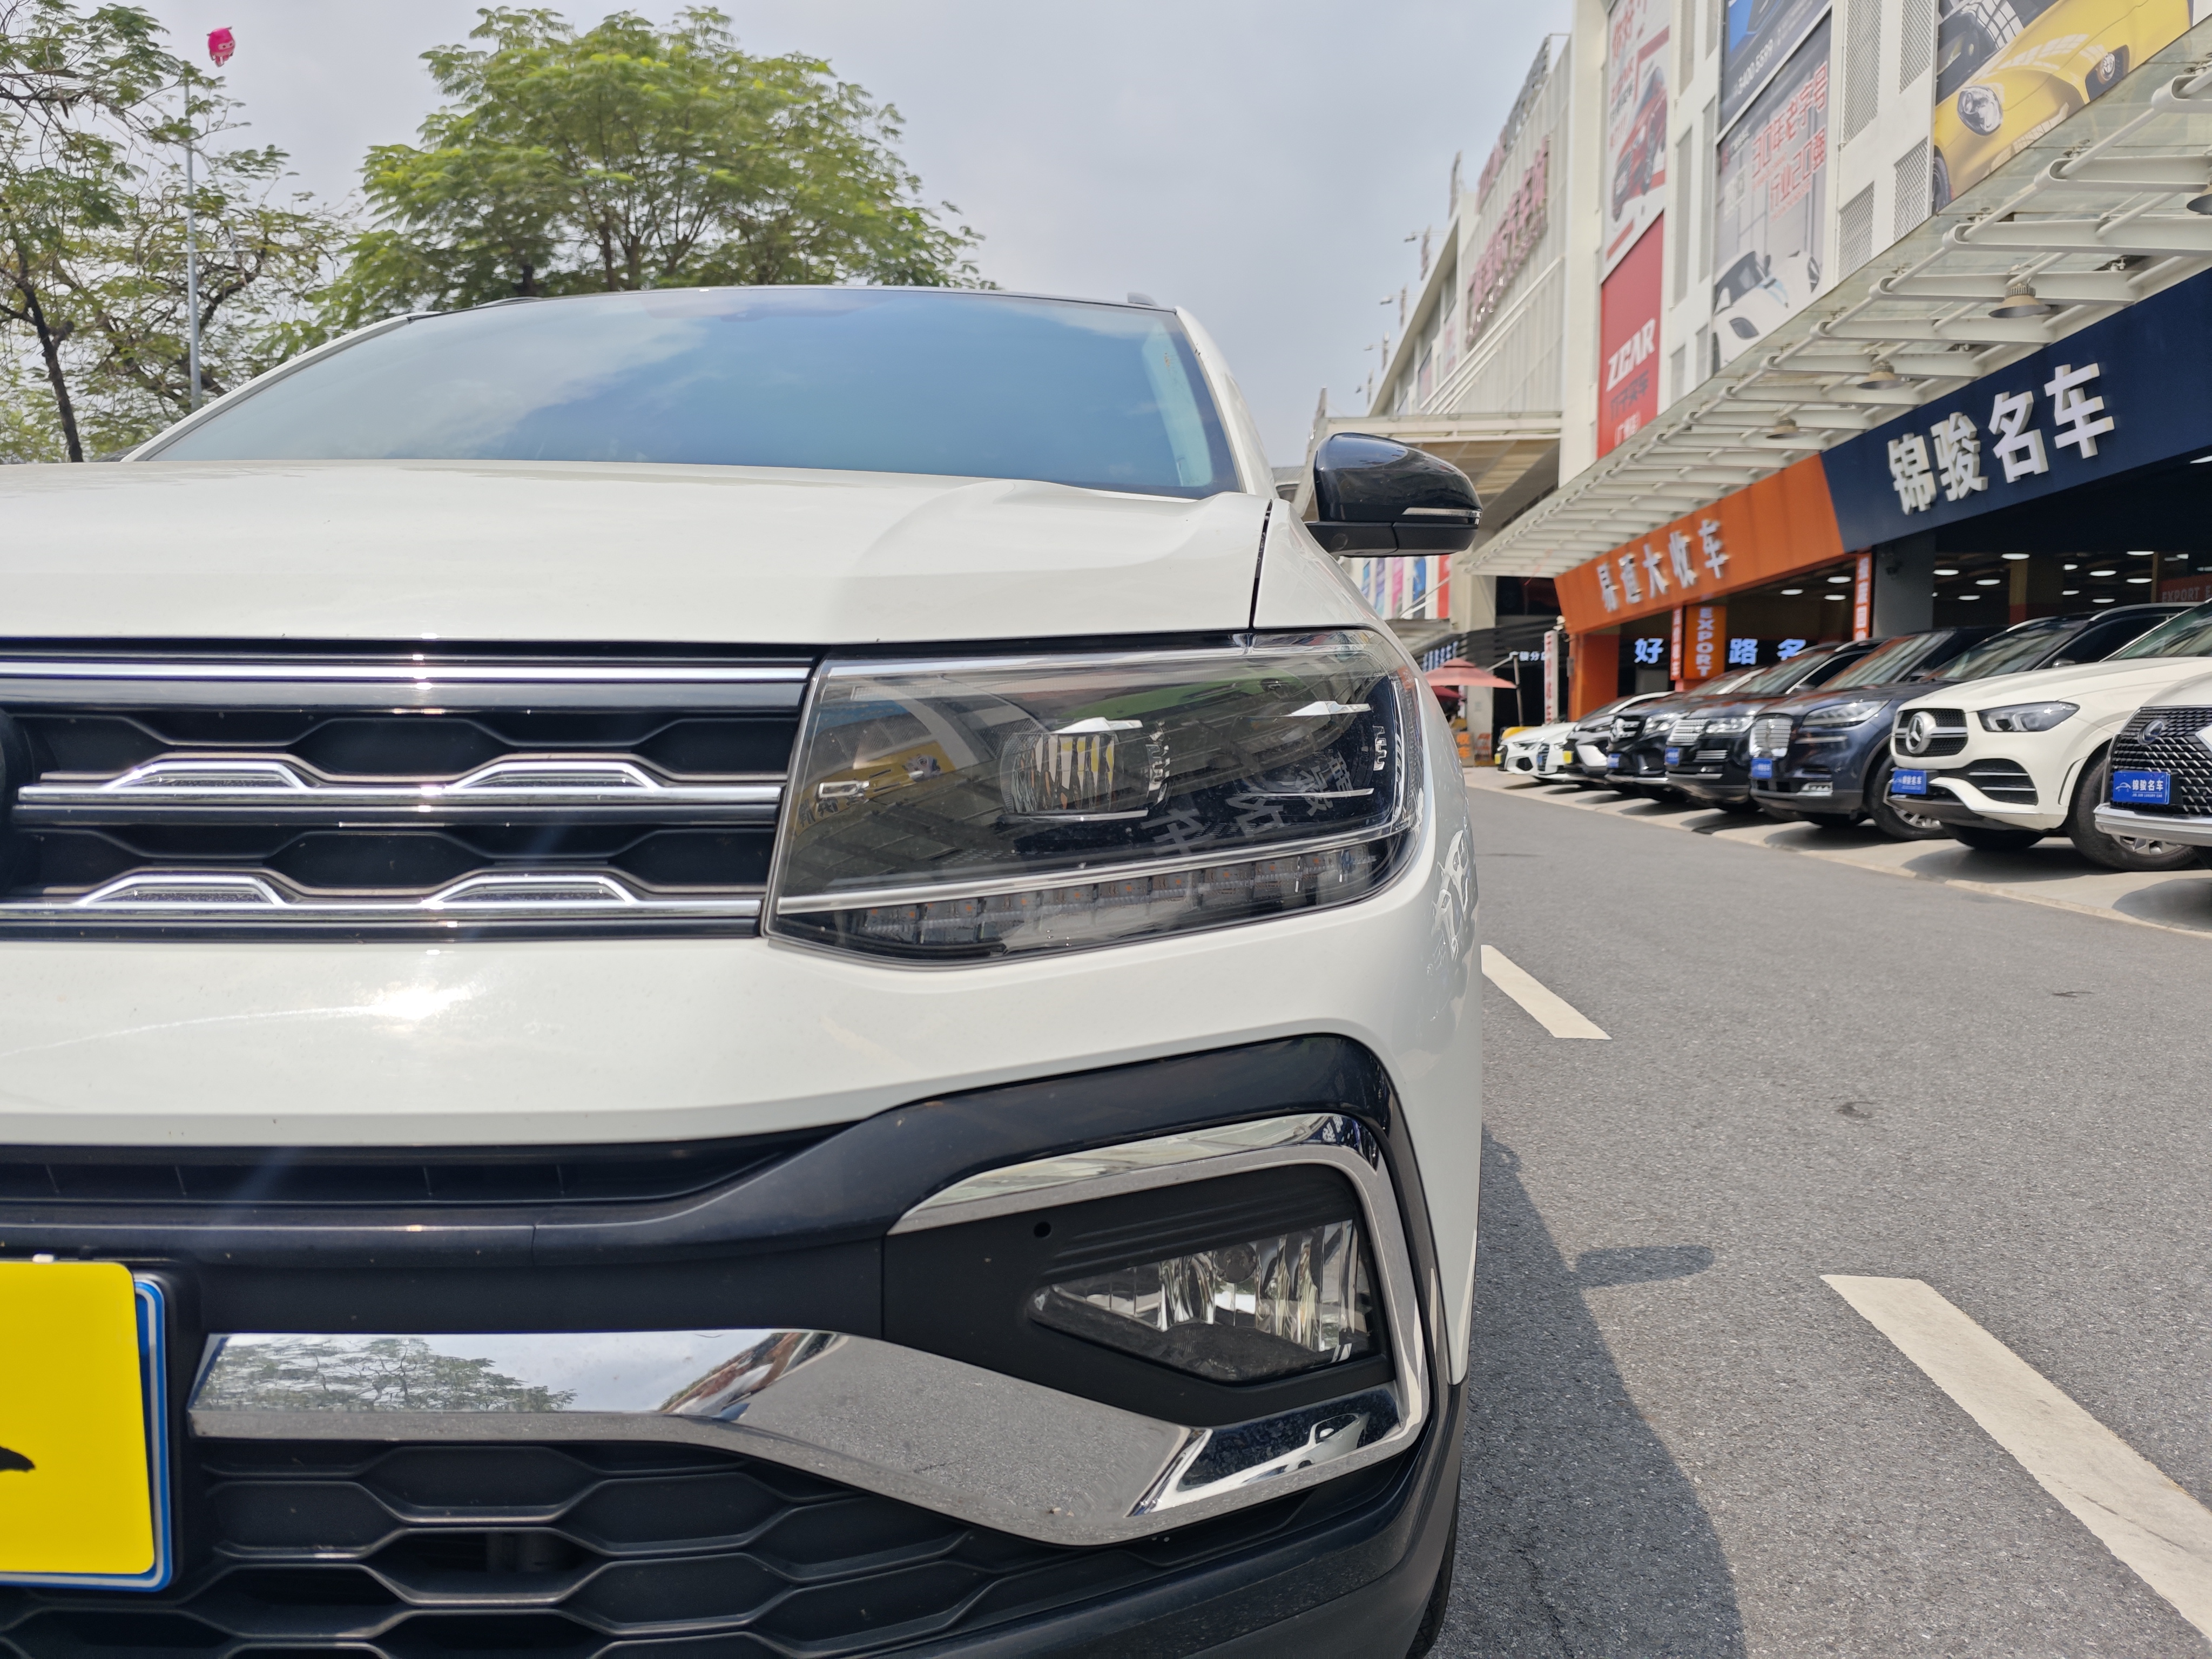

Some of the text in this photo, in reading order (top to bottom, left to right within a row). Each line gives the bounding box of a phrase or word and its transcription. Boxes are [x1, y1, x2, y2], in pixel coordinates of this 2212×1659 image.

[1887, 362, 2115, 515] 锦骏名车
[1696, 607, 1715, 677] EXPORT
[2132, 779, 2164, 792] 锦骏名车
